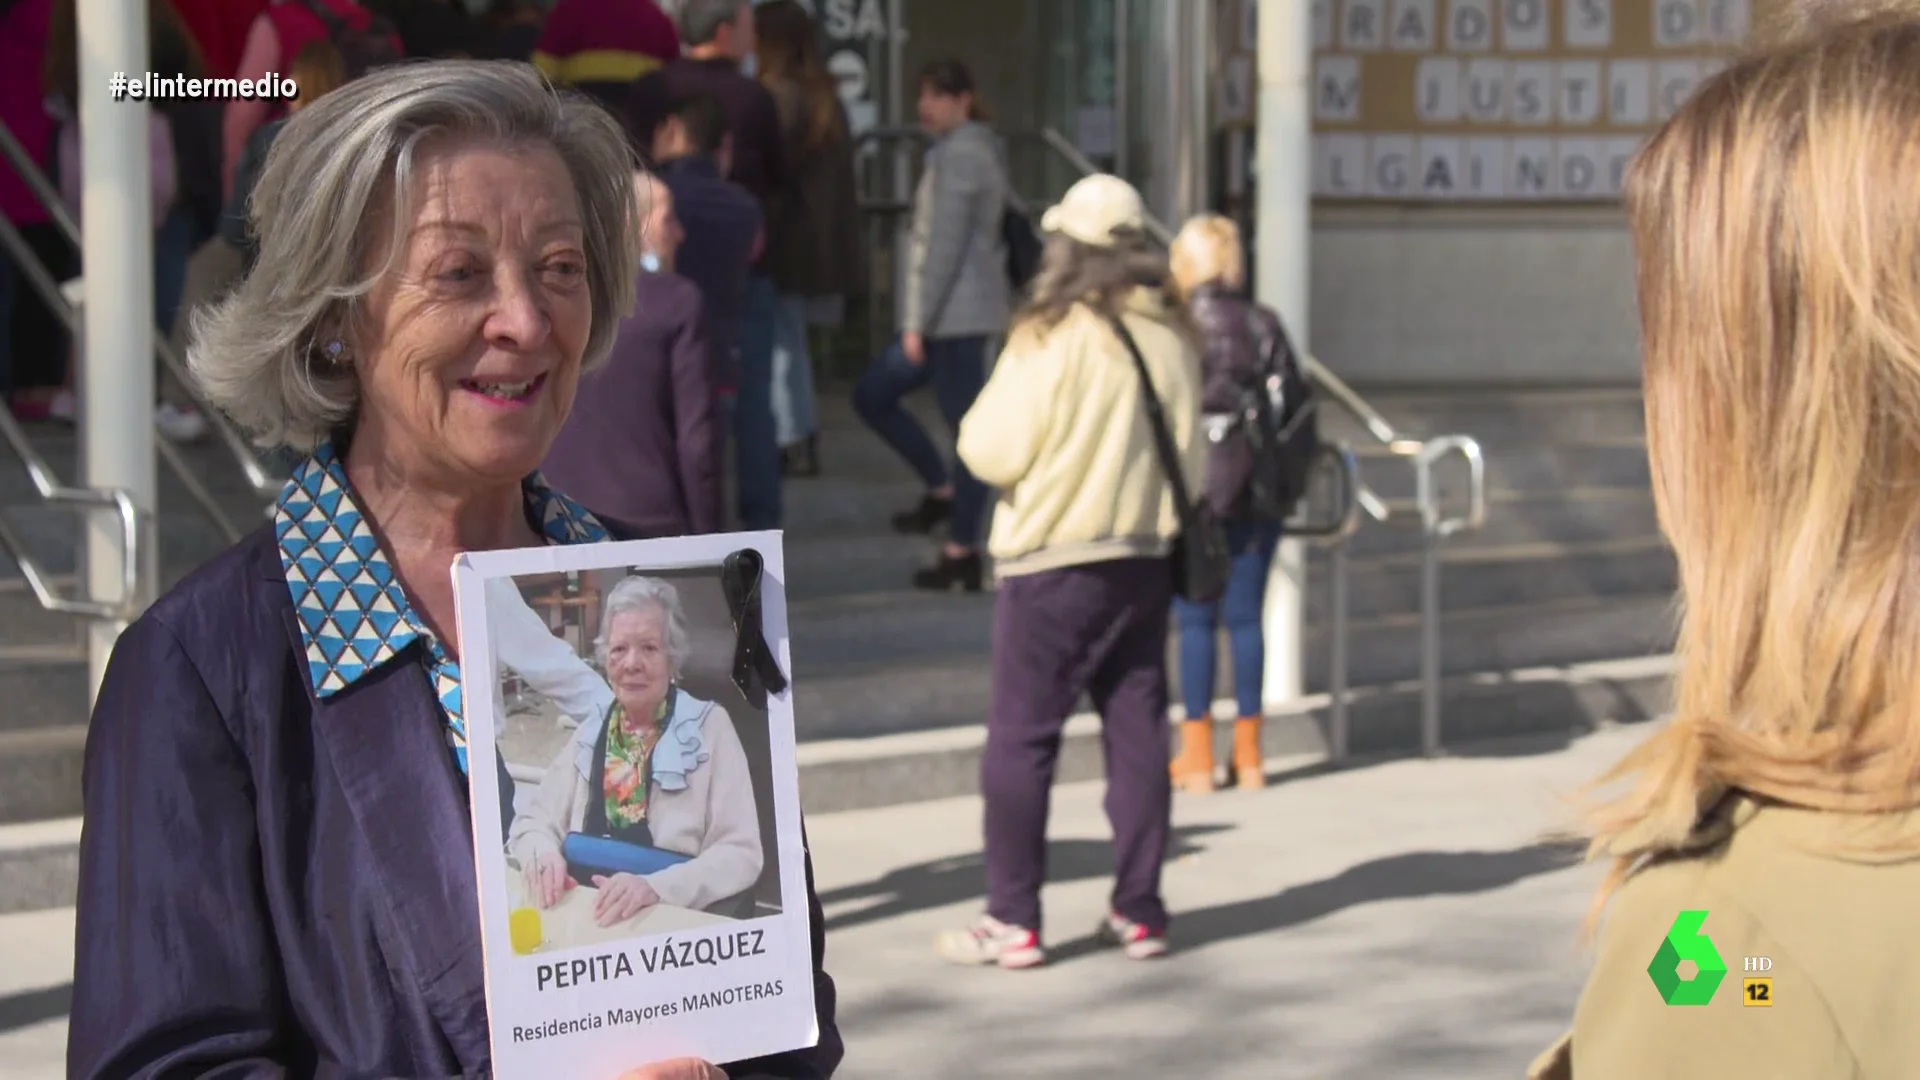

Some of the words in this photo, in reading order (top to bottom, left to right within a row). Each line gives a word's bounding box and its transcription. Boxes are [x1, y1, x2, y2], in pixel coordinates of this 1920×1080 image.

[1311, 0, 1606, 42] RADOS
[536, 951, 634, 992] PEPITA
[639, 929, 766, 973] VÁZQUEZ
[512, 1012, 602, 1043] Residencia
[607, 1001, 678, 1026] Mayores
[682, 979, 784, 1013] MANOTERAS
